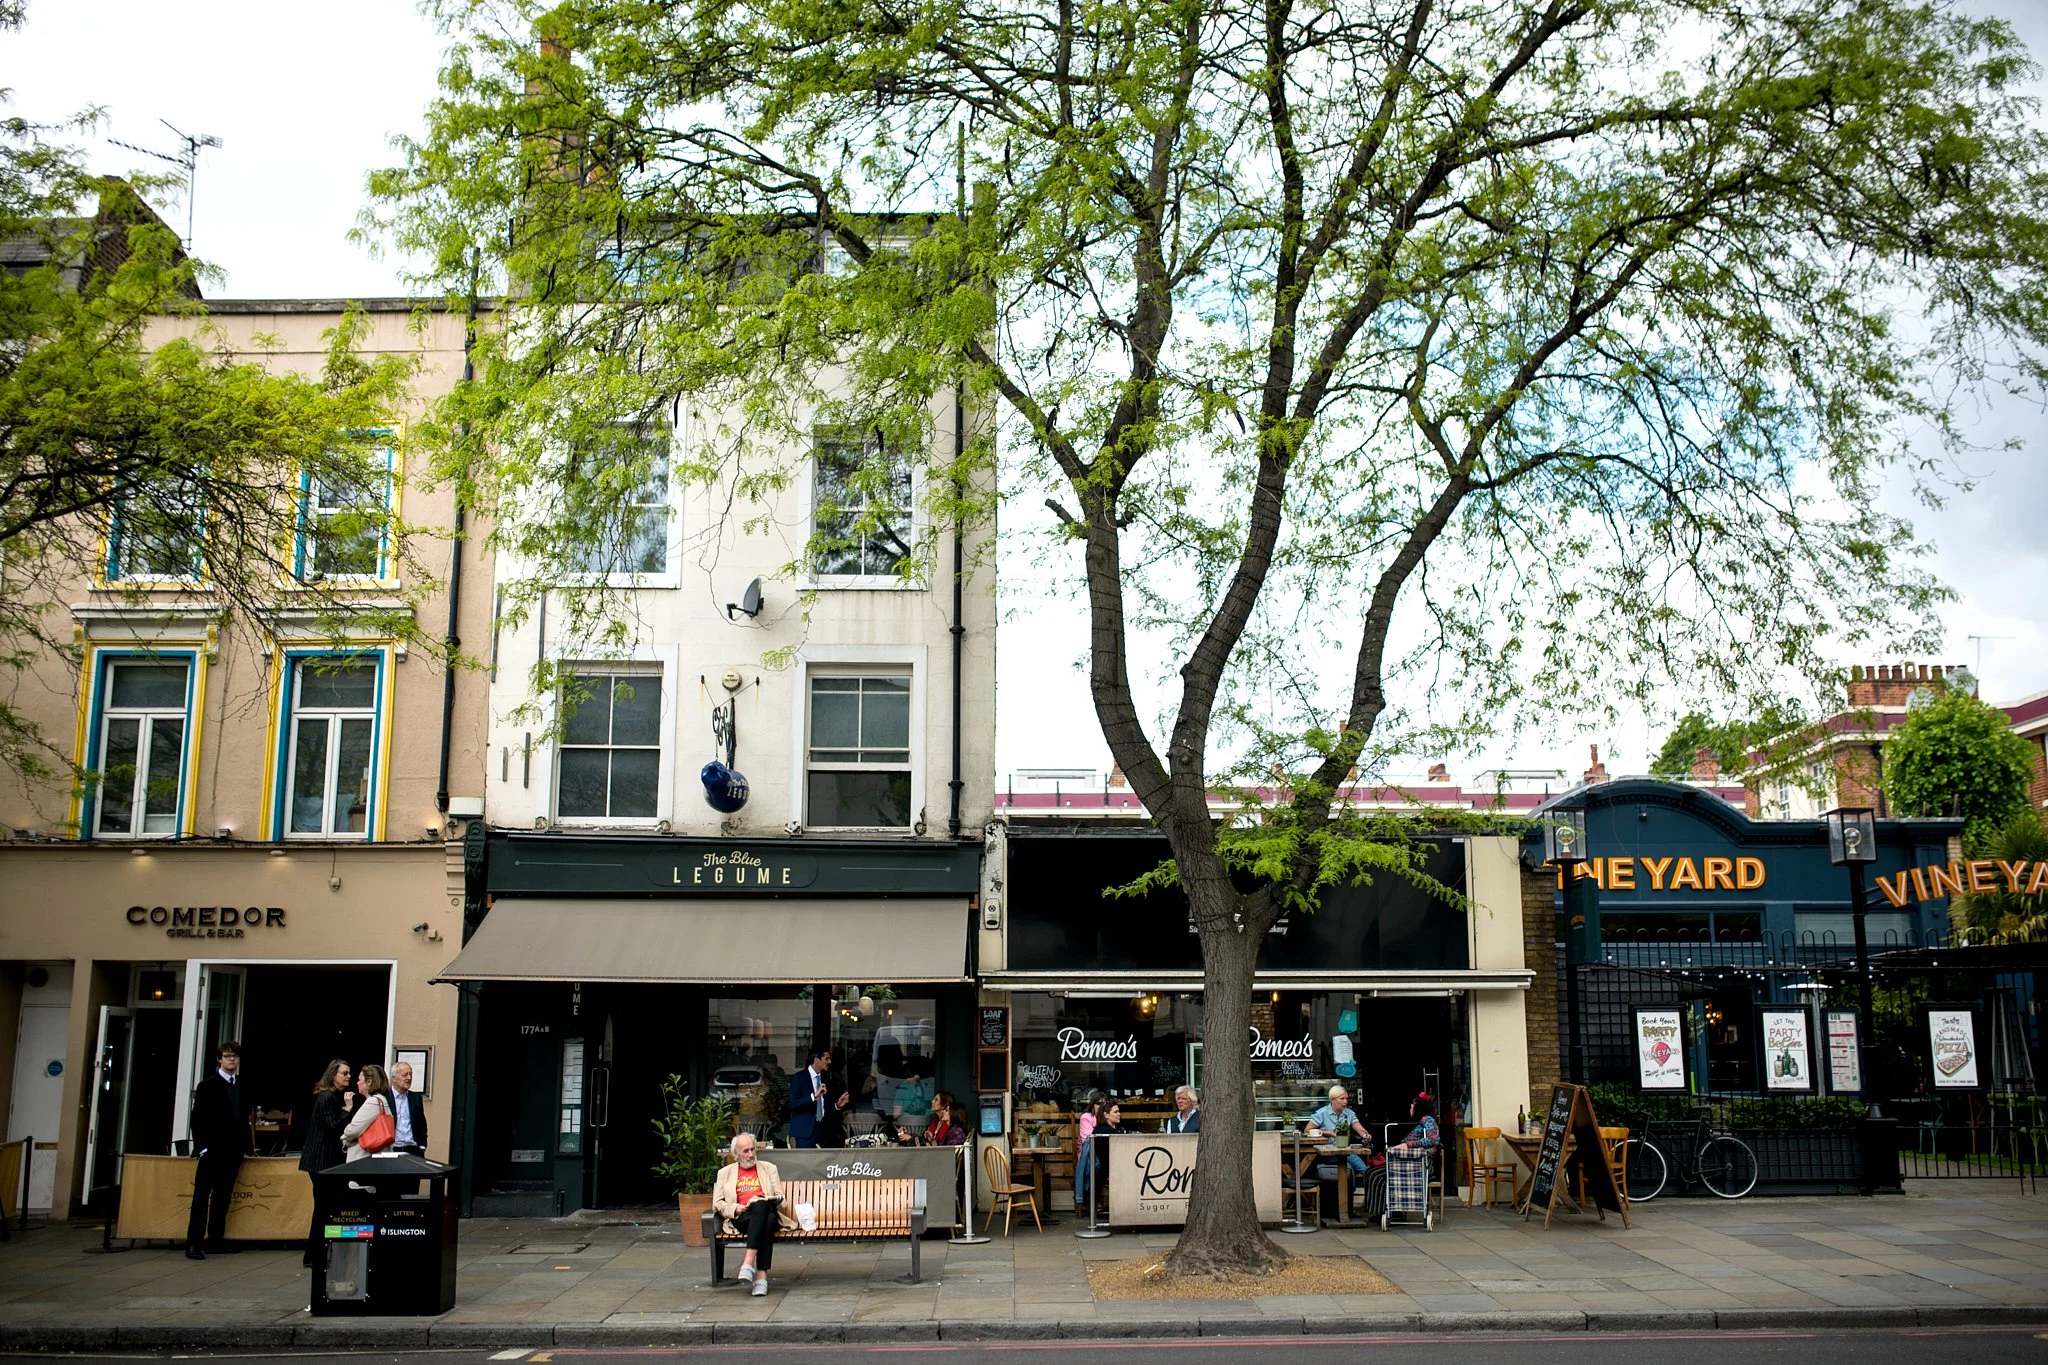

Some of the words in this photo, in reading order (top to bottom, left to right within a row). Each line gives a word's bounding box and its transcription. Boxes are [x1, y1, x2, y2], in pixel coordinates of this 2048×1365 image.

[703, 853, 727, 867] The
[728, 851, 761, 867] Blue
[673, 867, 791, 884] LEGUME
[1556, 857, 1767, 890] NEYARD
[126, 906, 286, 927] COMEDOR
[166, 928, 205, 938] GRILL
[207, 929, 216, 938] &
[217, 929, 244, 938] BAR
[1643, 1026, 1677, 1038] PARTY
[1769, 1028, 1802, 1038] PARTY
[1057, 1027, 1138, 1060] Romeo's
[1935, 1042, 1968, 1055] PIZZA
[826, 1164, 850, 1178] The
[851, 1162, 882, 1177] Blue
[1140, 1203, 1170, 1212] Sugar
